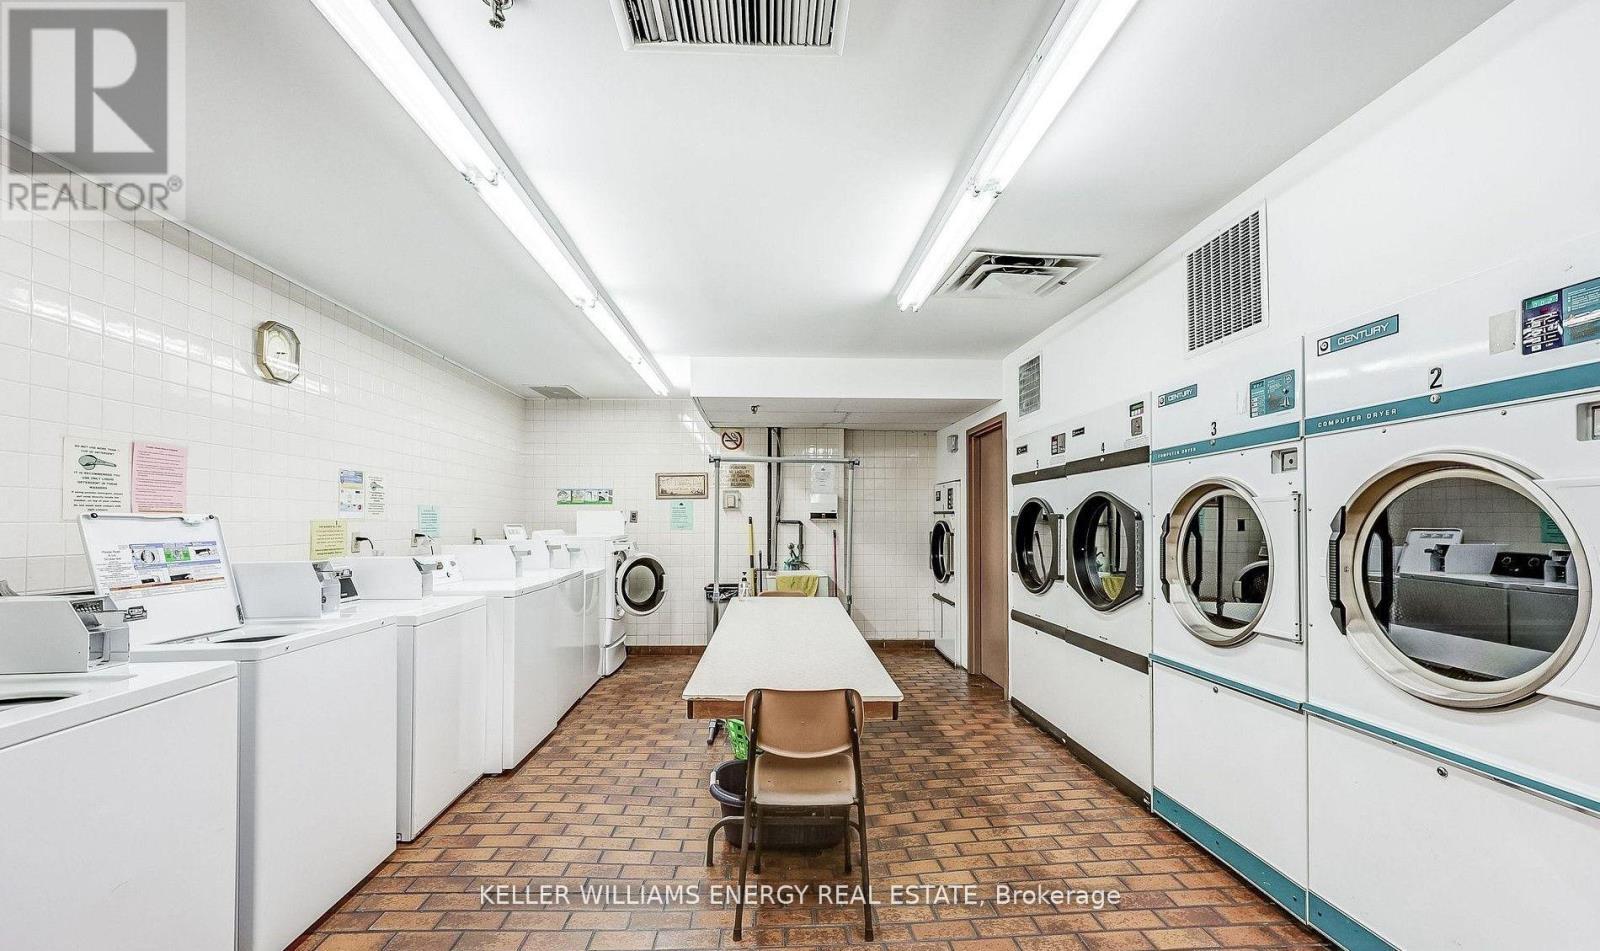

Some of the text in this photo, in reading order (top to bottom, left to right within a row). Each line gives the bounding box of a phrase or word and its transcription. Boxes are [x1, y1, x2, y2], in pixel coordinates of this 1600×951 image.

[1337, 322, 1389, 346] CENTURY
[1429, 367, 1443, 390] 2
[1167, 389, 1193, 402] CENTURY
[1317, 408, 1398, 428] COMPUTER DRYER
[1210, 421, 1217, 436] 3
[1100, 442, 1105, 454] 4
